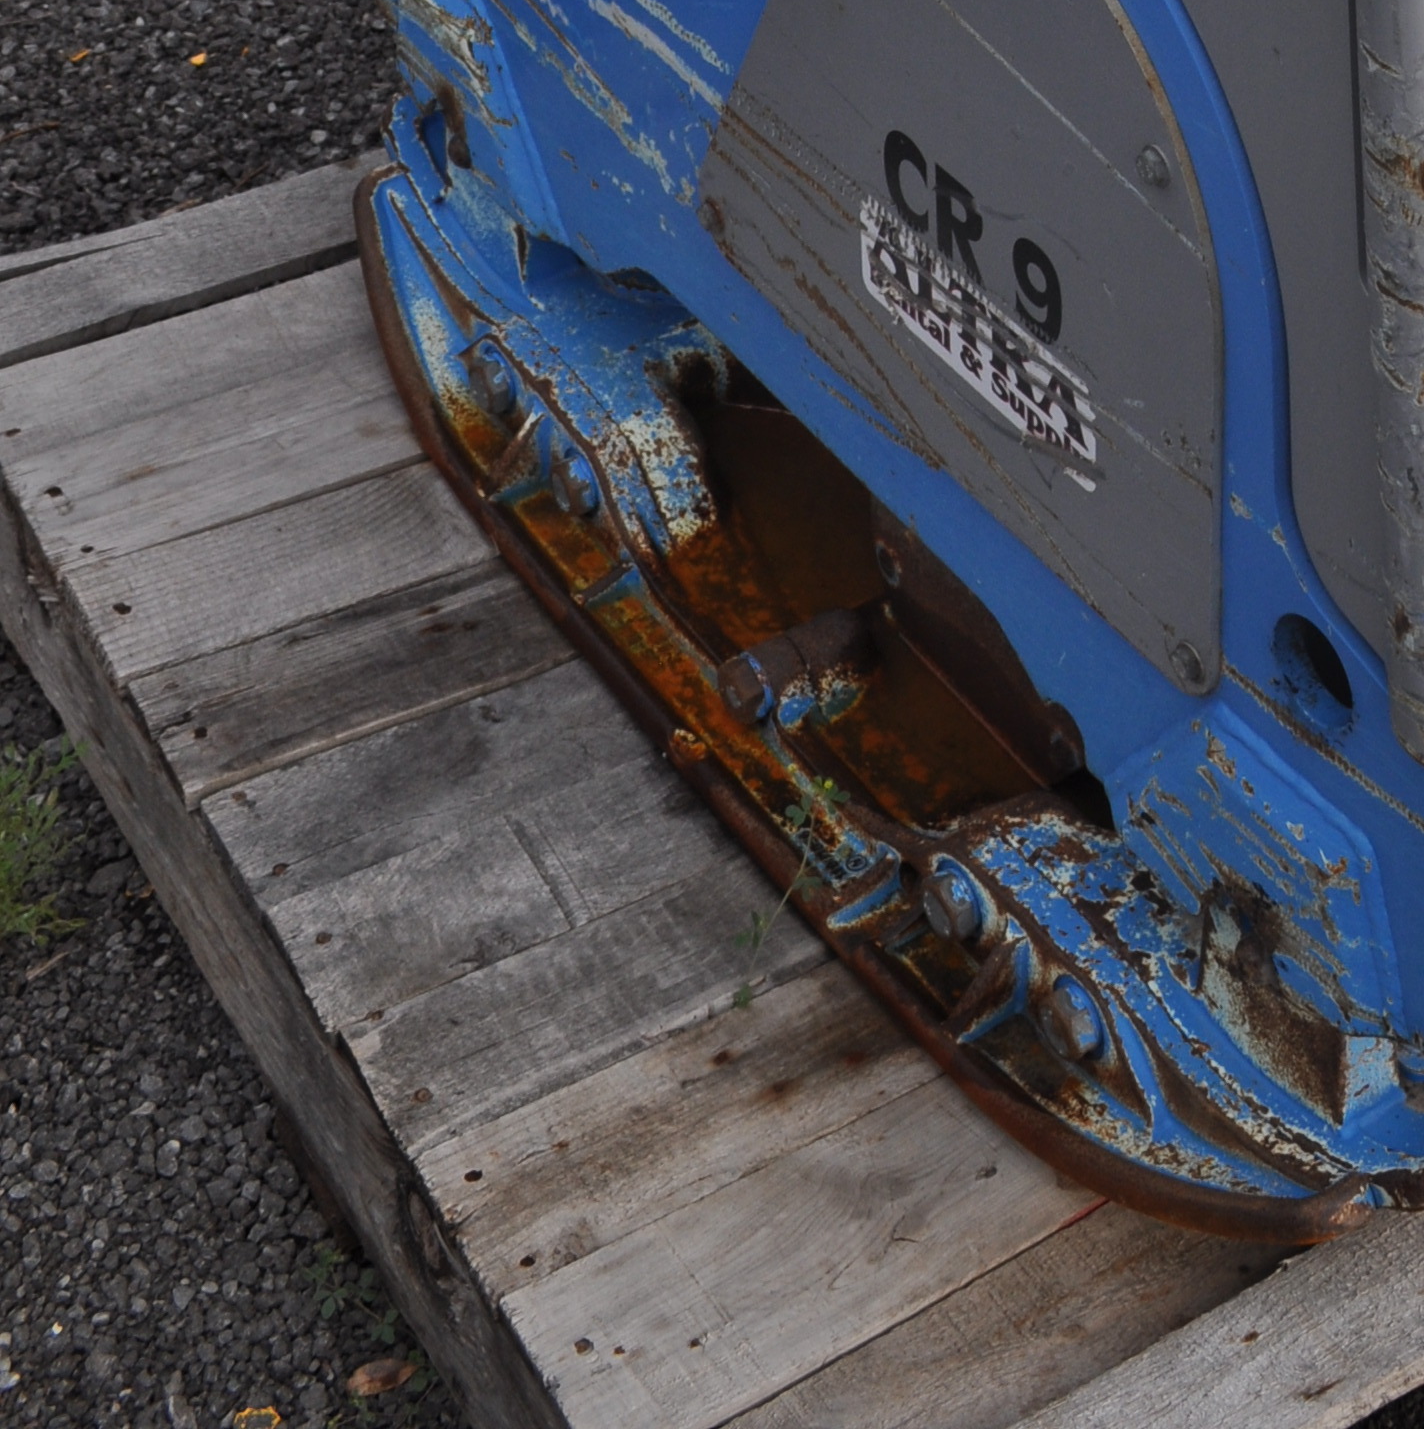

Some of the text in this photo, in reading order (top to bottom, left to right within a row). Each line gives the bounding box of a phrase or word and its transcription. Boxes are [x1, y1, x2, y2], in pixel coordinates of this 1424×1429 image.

[884, 130, 1063, 345] CR 9
[959, 344, 983, 381] &
